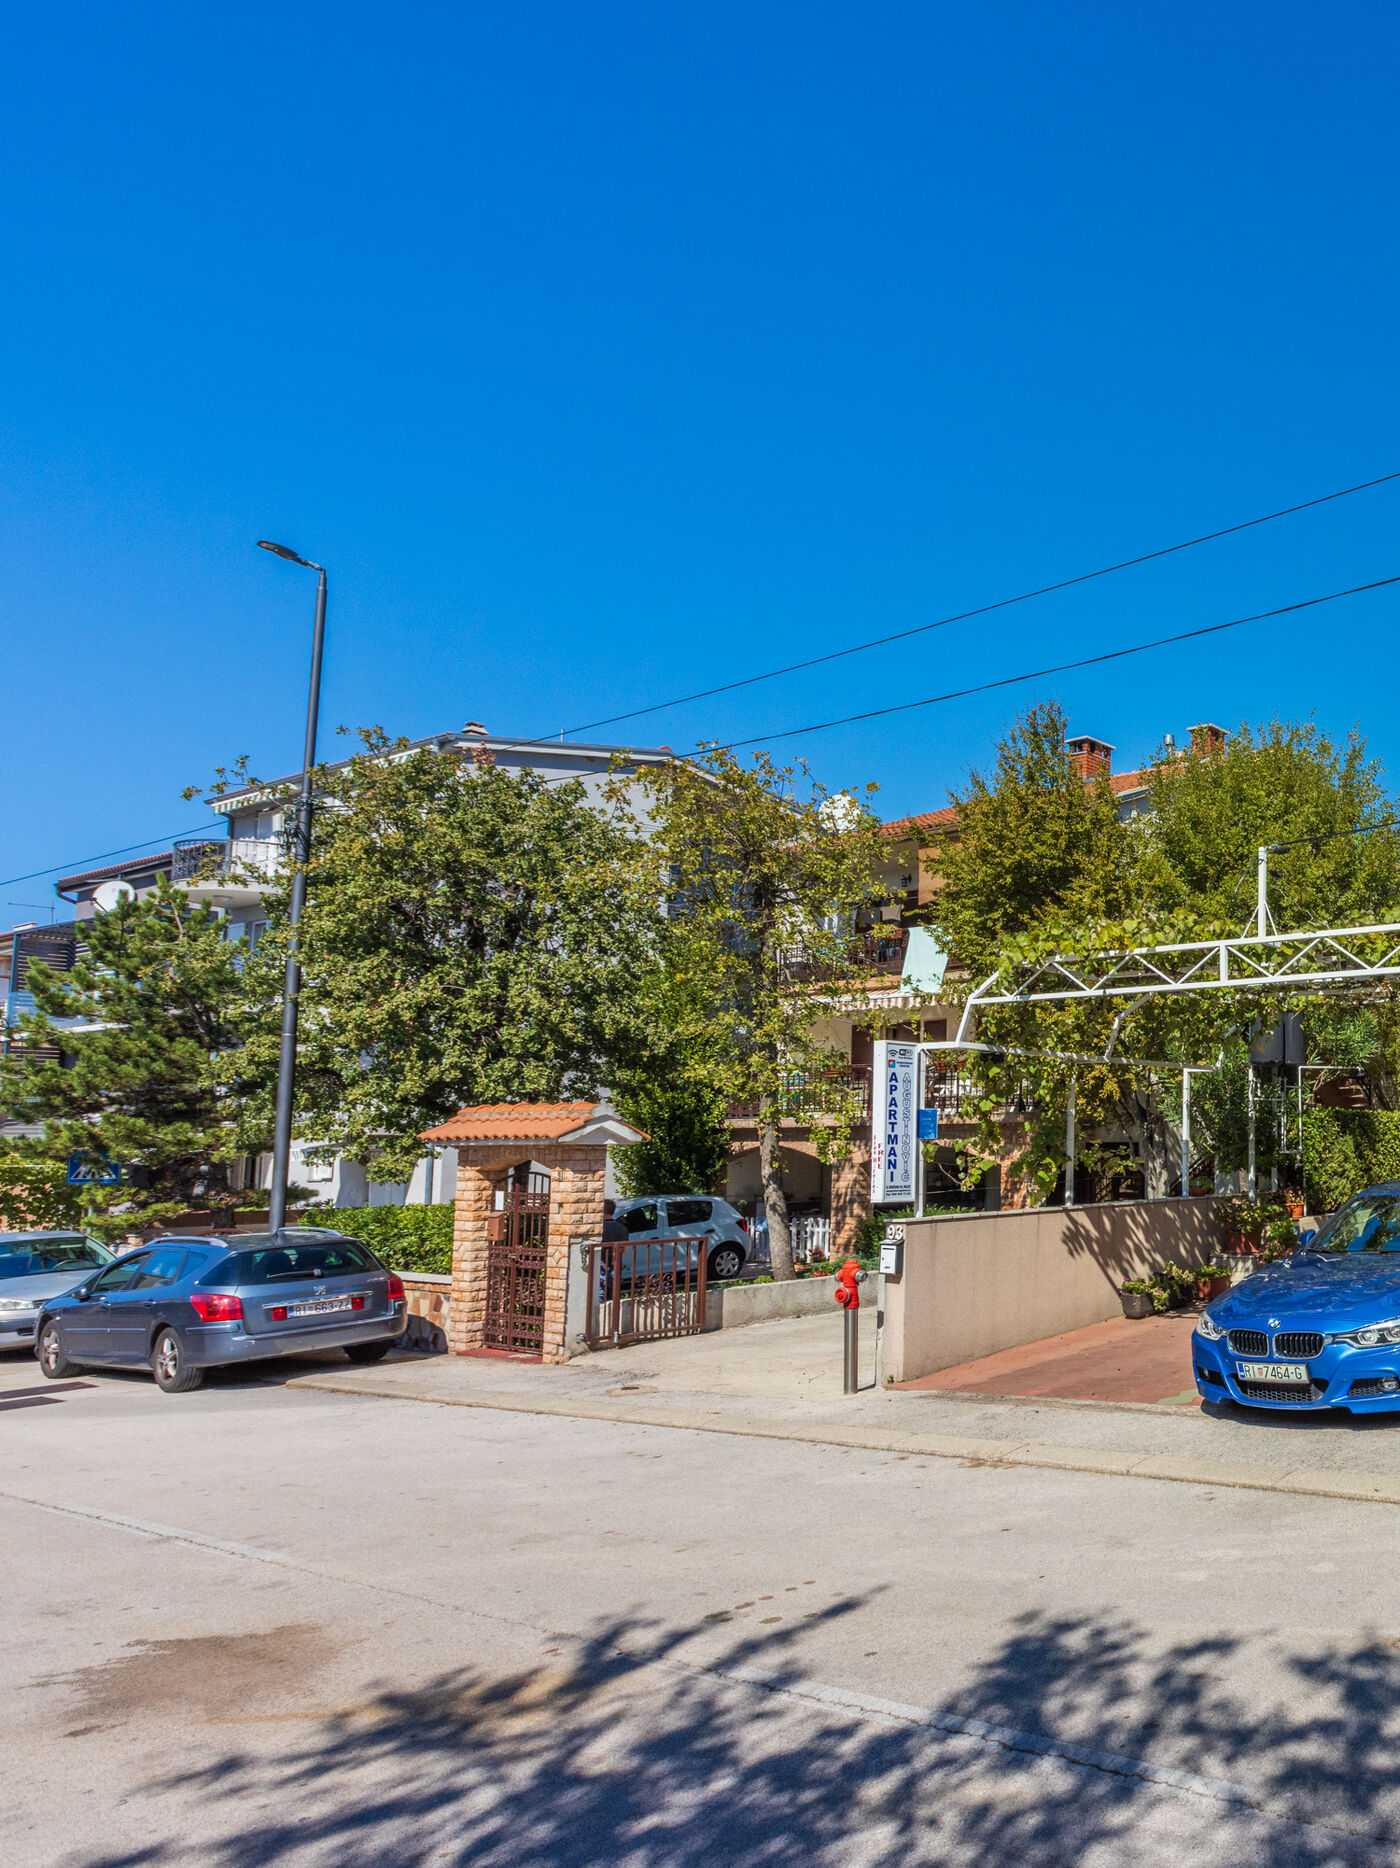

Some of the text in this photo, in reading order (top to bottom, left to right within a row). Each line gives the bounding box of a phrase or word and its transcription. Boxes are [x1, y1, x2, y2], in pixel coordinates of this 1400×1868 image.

[887, 1072, 898, 1182] APARTMANI
[887, 1224, 903, 1240] 93
[1244, 1365, 1302, 1380] RI 7464-G
